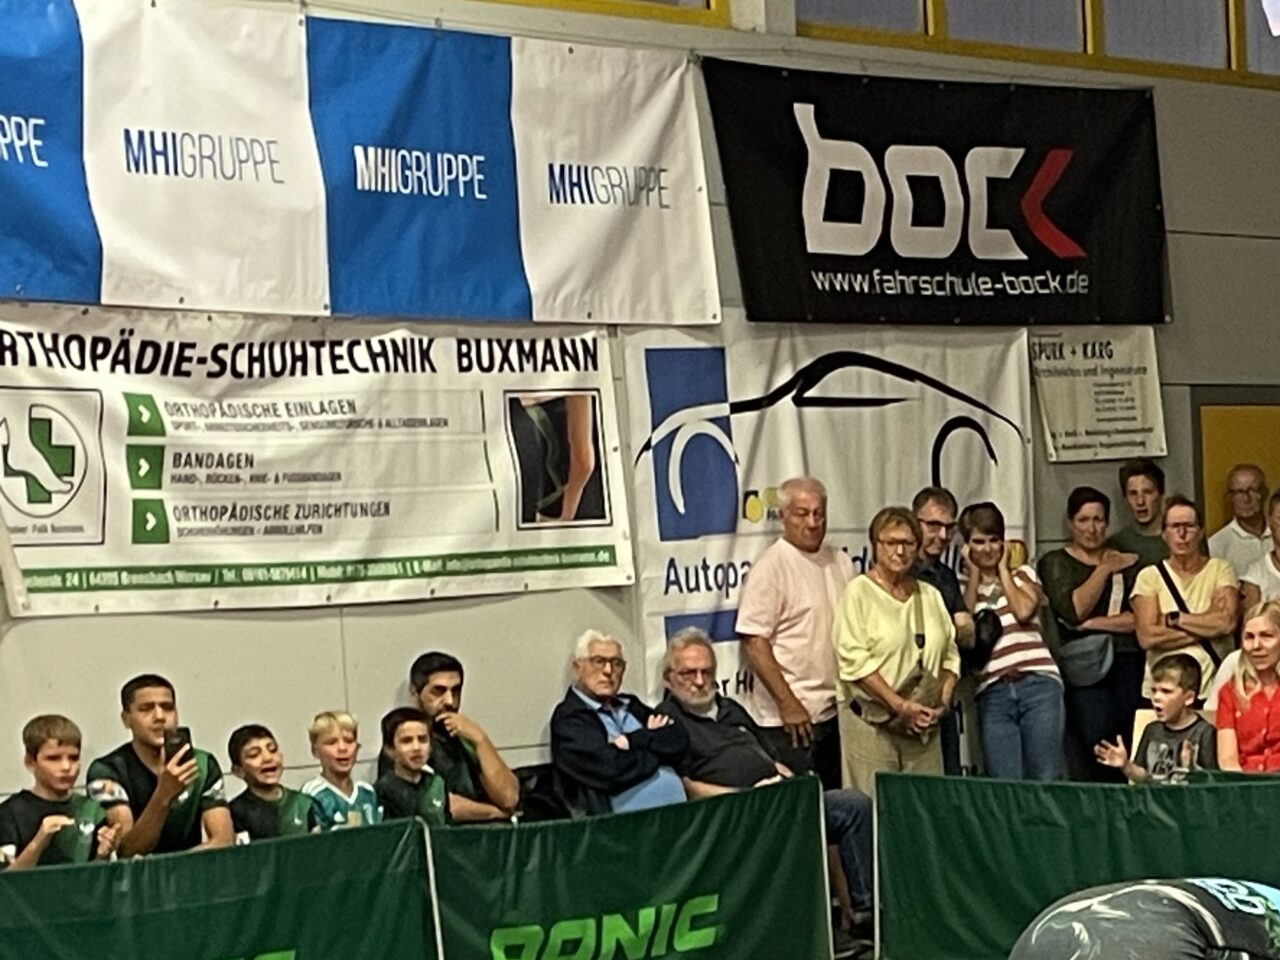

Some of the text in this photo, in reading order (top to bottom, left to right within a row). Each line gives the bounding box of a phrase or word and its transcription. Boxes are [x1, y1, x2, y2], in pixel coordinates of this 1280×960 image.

[124, 127, 285, 185] MHIGRUPPE
[353, 145, 488, 200] MHIGRUPPE
[547, 163, 671, 210] MHIGRUPPE
[811, 269, 1089, 297] www.fahrschule-bock.de
[457, 336, 599, 374] BUXMANN
[164, 399, 358, 419] ORTHOPÄDISCHE EINLAGEN
[172, 452, 255, 469] BANDAGEN
[172, 500, 392, 522] ORTHOPÄDISCHE ZURICHTUNGEN
